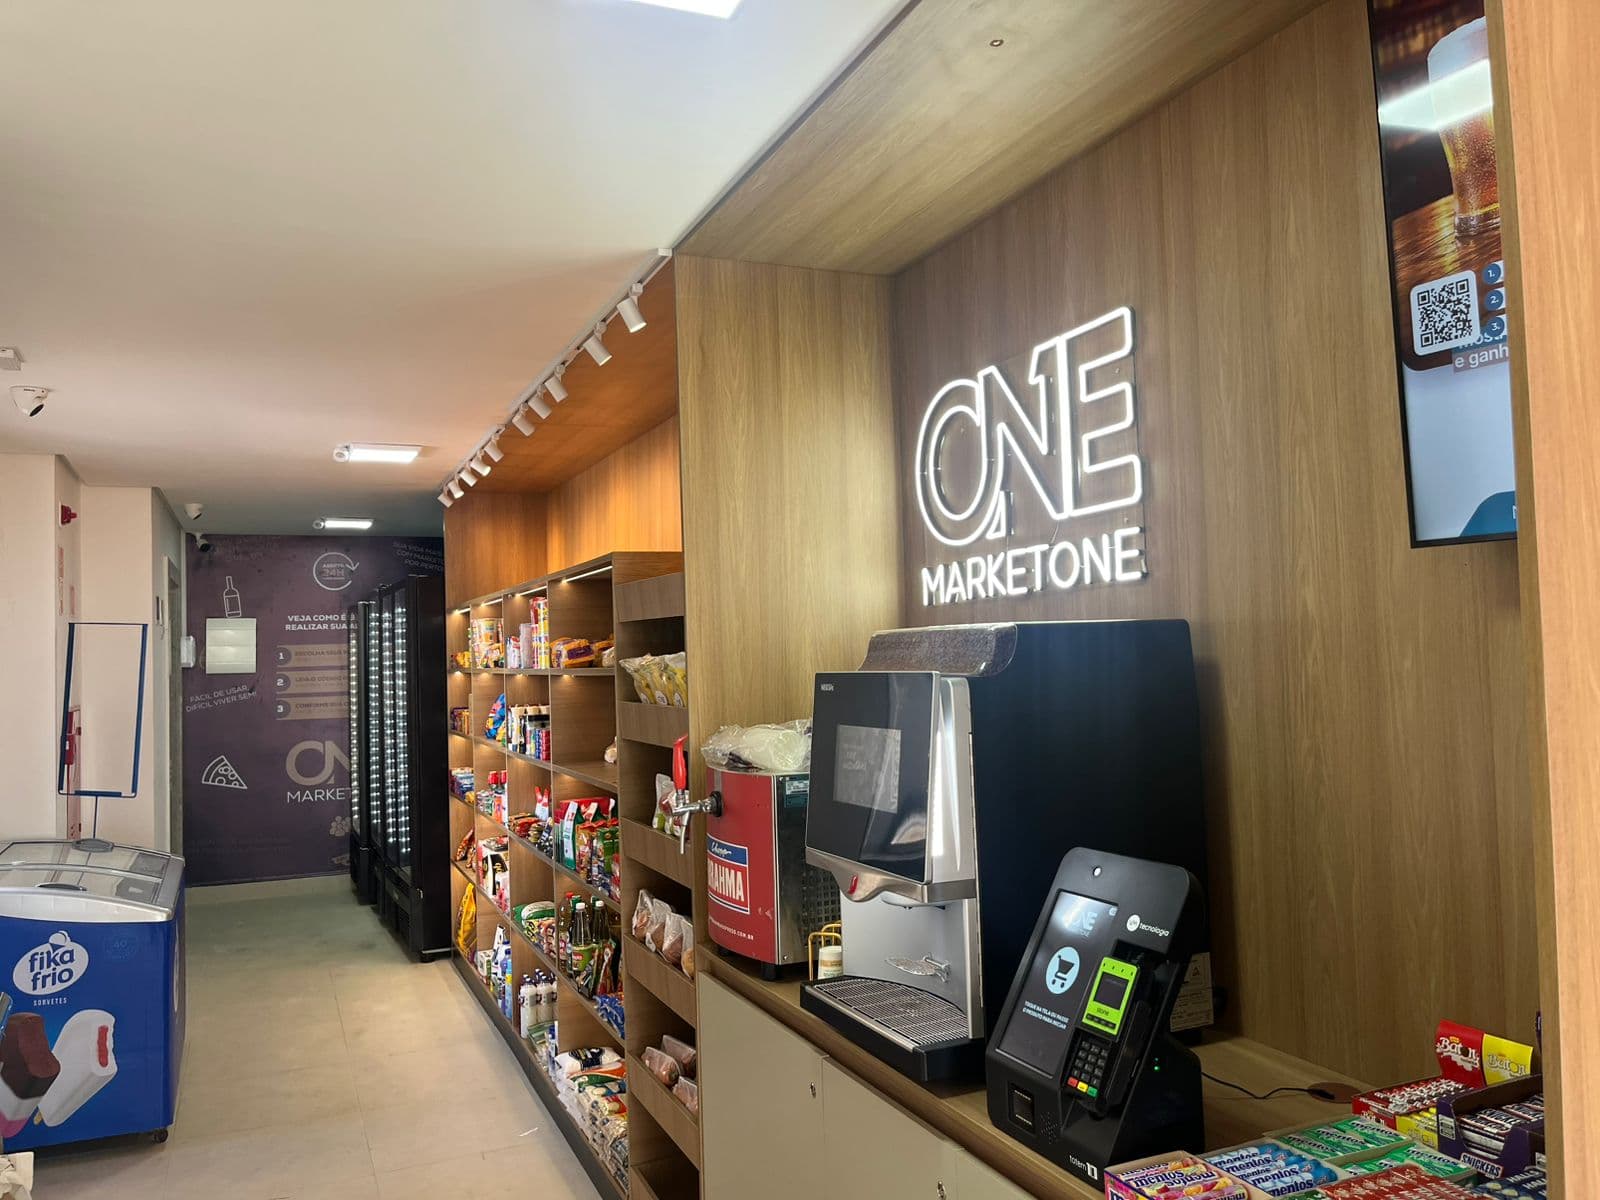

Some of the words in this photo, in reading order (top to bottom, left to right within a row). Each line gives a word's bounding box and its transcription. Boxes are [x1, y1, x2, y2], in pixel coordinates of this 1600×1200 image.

[1455, 357, 1465, 369] e
[915, 303, 1143, 548] ONE
[920, 527, 1144, 606] MARKETONE
[288, 614, 311, 622] VEJA
[313, 613, 339, 621] COMO
[285, 623, 328, 631] REALIZAR
[330, 622, 348, 630] SUA
[278, 652, 285, 660] 1
[276, 678, 284, 687] 2
[276, 704, 284, 713] 3
[29, 949, 75, 973] fika
[31, 967, 74, 991] frio
[33, 998, 68, 1007] SORVETES
[1226, 1156, 1273, 1173] mentos
[1461, 1155, 1501, 1177] SNICKERS
[1133, 1170, 1185, 1188] mentos
[1250, 1167, 1300, 1186] mentos
[1268, 1179, 1314, 1198] mentos
